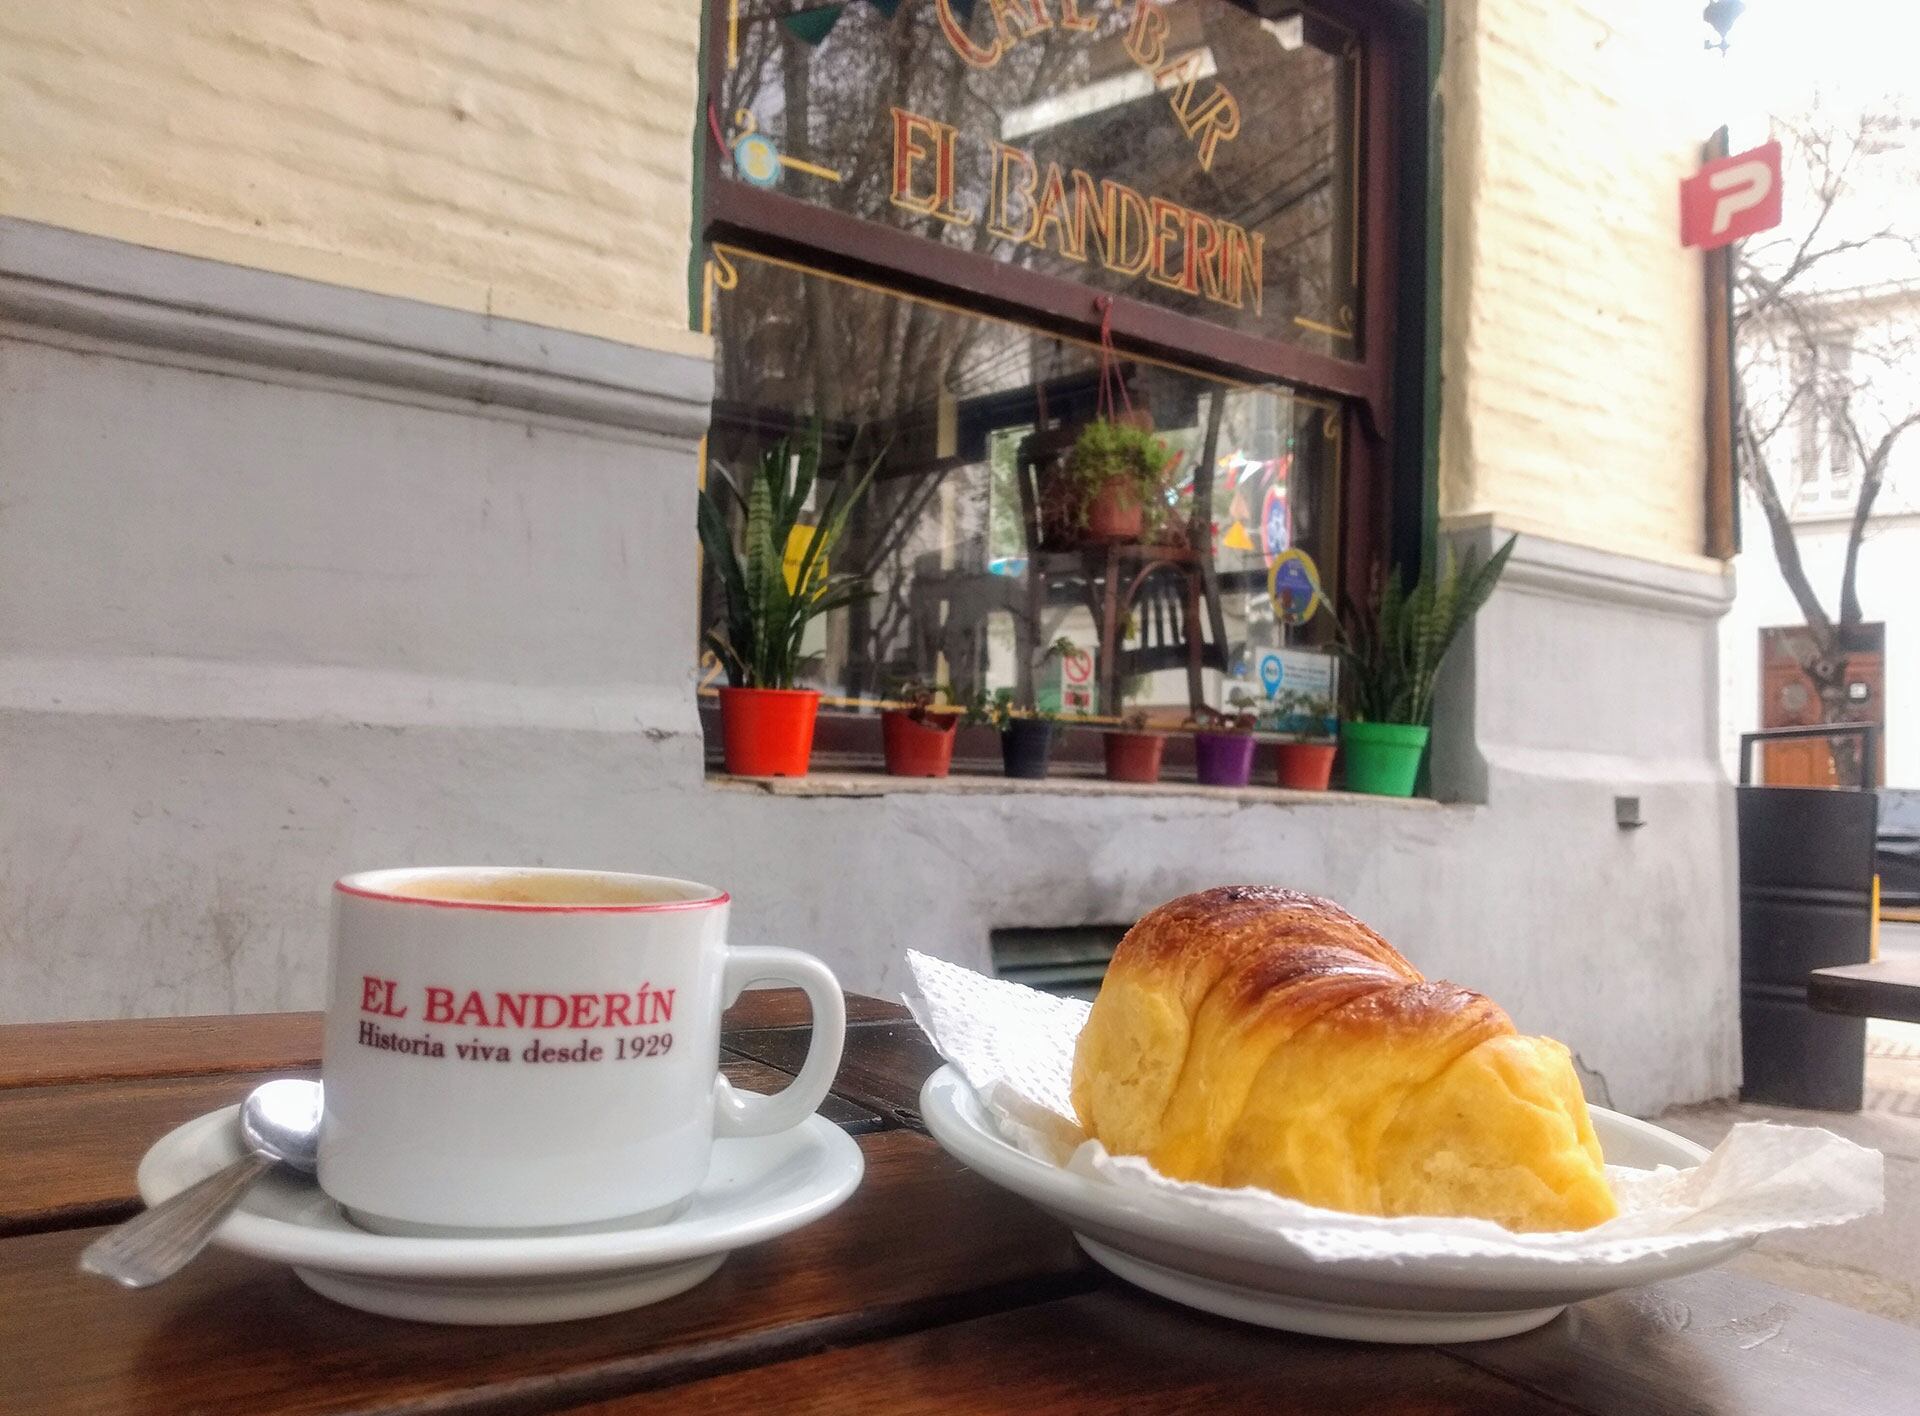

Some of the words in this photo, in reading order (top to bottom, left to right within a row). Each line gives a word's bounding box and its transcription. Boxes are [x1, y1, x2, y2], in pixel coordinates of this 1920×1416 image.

[1122, 0, 1241, 172] BAR
[890, 107, 976, 226] EL
[986, 138, 1266, 317] BANDERIN
[1710, 161, 1772, 235] P
[361, 976, 408, 1018] EL
[422, 981, 676, 1029] BANDERÍN
[358, 1019, 445, 1058] Historia
[456, 1037, 510, 1062] viva
[522, 1038, 603, 1063] desde
[614, 1032, 674, 1060] 1929
